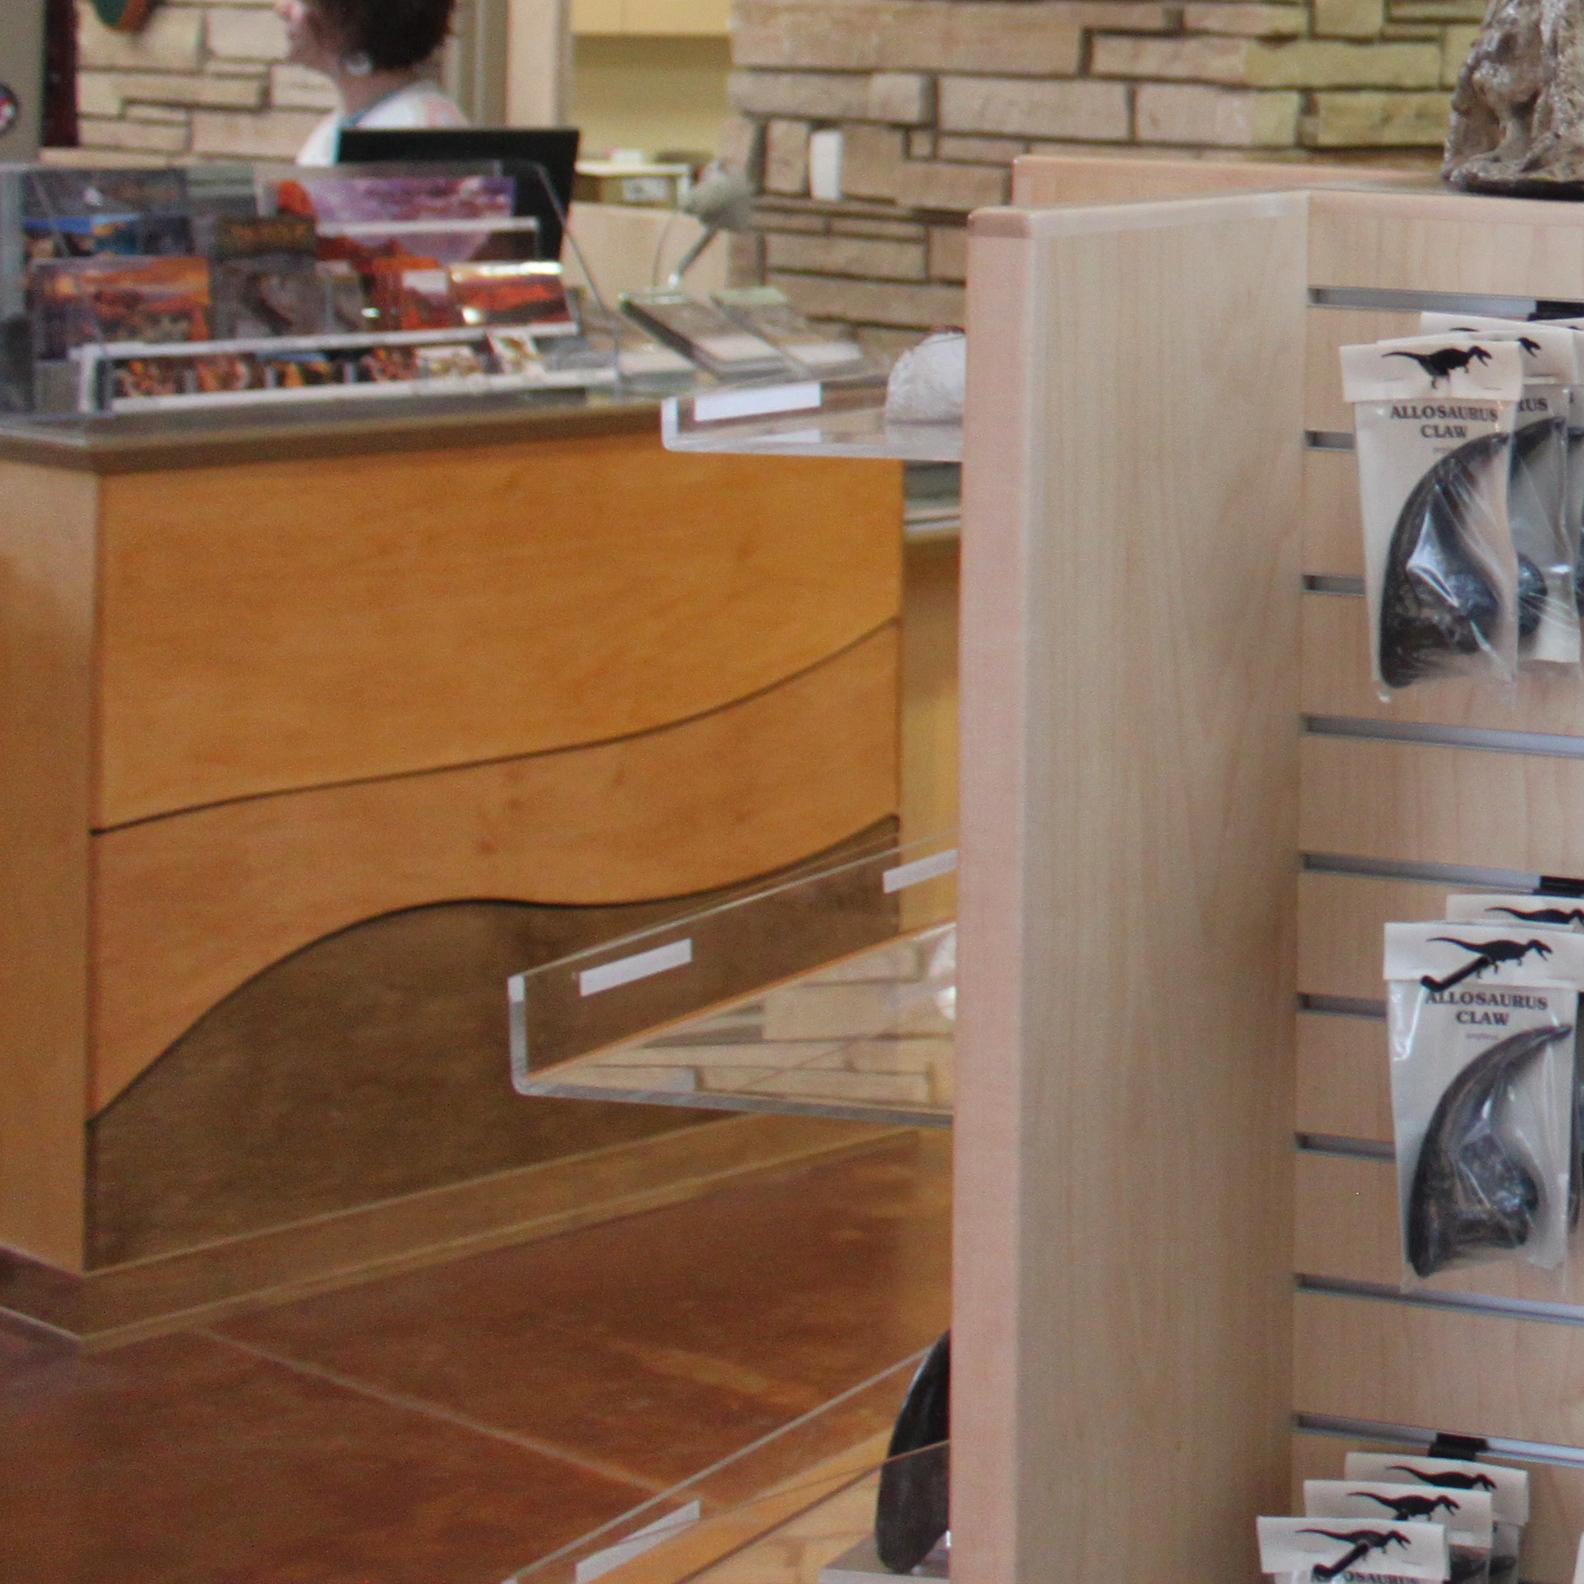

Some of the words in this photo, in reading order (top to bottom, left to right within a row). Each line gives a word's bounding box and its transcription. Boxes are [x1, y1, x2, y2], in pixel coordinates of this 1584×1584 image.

[1391, 404, 1499, 422] ALLOSAURUS
[1420, 424, 1468, 439] CLAW
[1425, 991, 1549, 1011] ALLOSAURUS
[1455, 1010, 1510, 1027] CLAW
